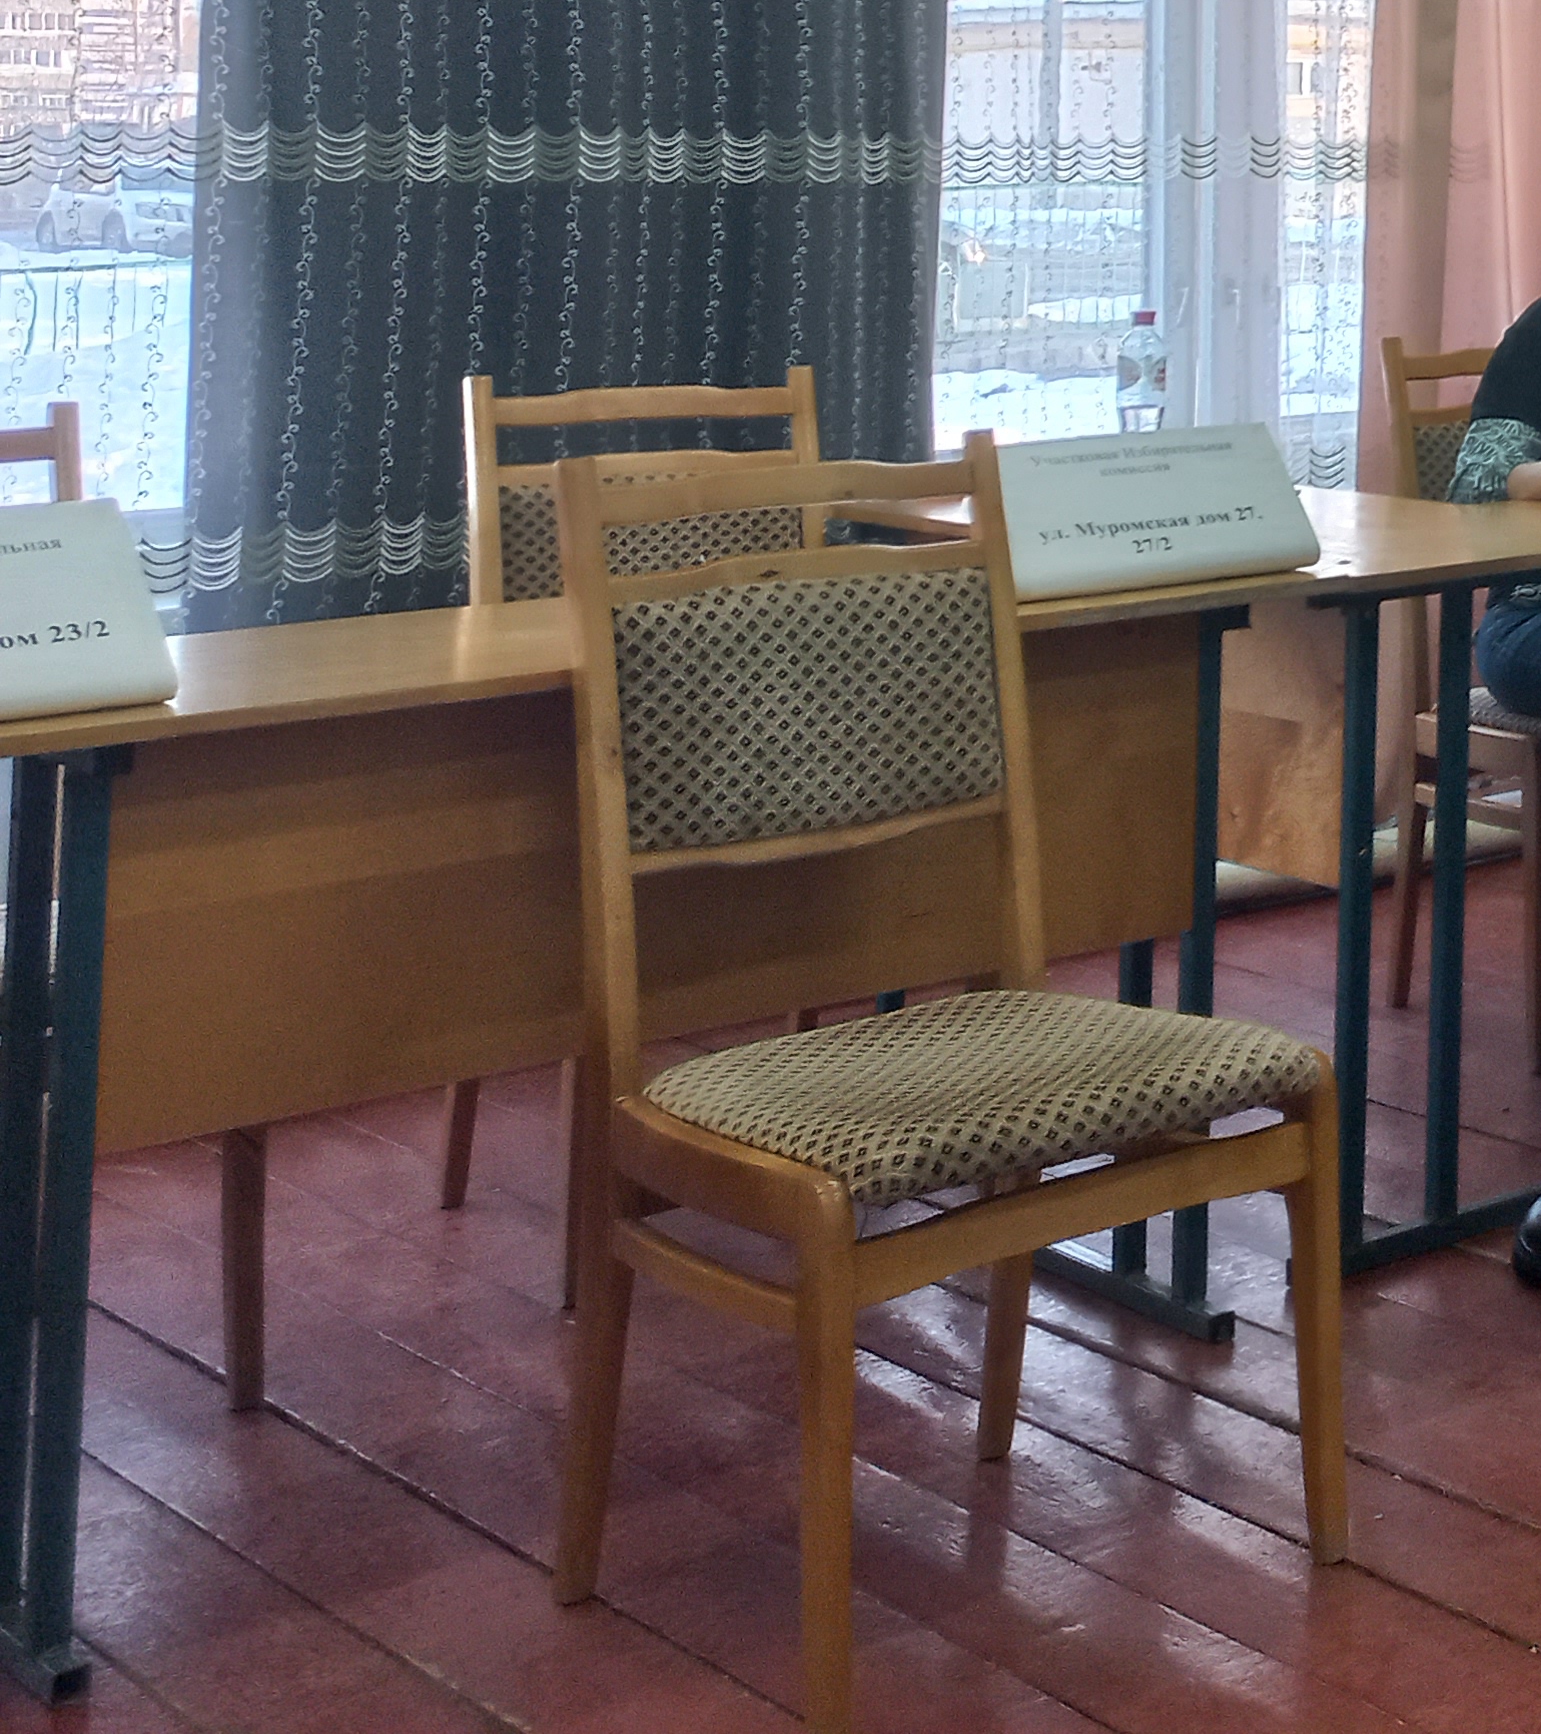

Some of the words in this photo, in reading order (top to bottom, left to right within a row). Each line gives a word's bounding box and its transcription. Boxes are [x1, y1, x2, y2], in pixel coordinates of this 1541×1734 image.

[1039, 528, 1070, 545] ул.
[1075, 516, 1189, 539] Муромская
[1197, 512, 1231, 526] дом
[1132, 536, 1173, 554] 27/2
[0, 632, 39, 649] ом
[48, 619, 111, 644] 23/2
